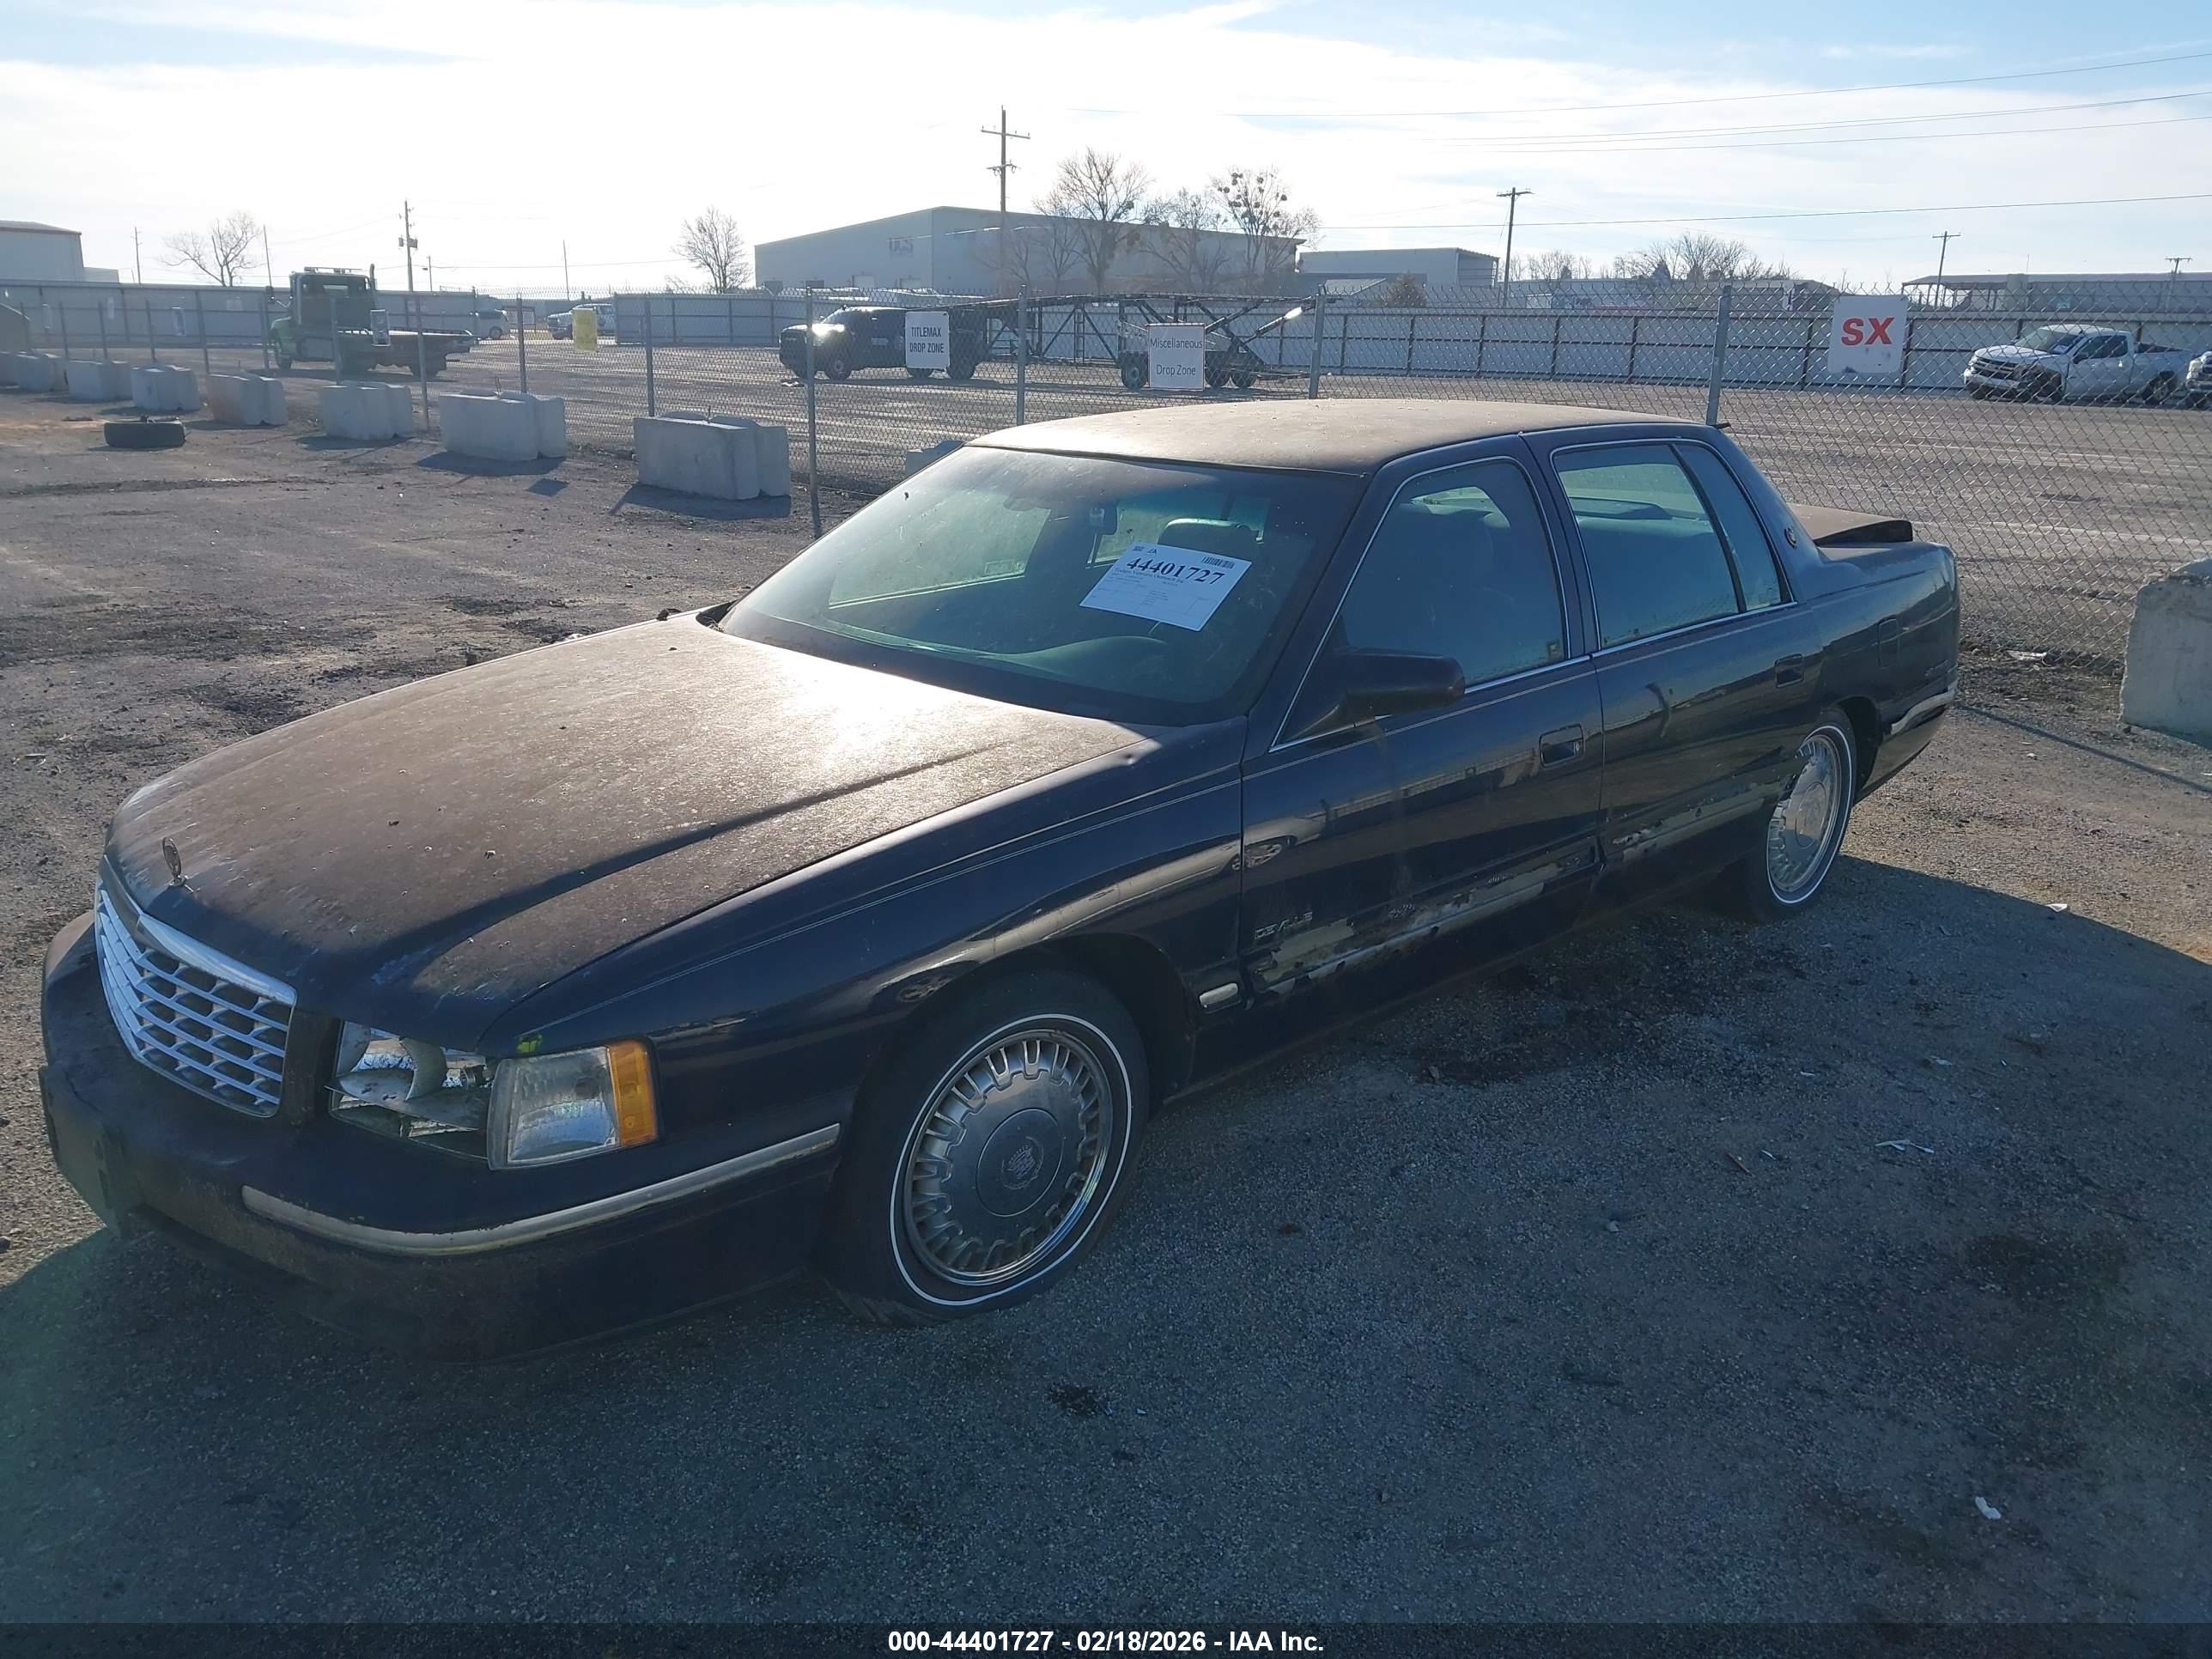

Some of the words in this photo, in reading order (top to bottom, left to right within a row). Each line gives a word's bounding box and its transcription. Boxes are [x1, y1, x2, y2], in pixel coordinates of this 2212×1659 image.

[911, 326, 942, 337] TITLEMAX
[1840, 317, 1895, 346] SX
[909, 343, 926, 354] DROP
[927, 343, 945, 354] ZONE
[1150, 337, 1203, 349] Miscellaneous
[1156, 364, 1176, 377] Drop
[1176, 364, 1196, 375] Zone
[1126, 557, 1225, 585] 44401727
[1254, 911, 1313, 940] DEVE
